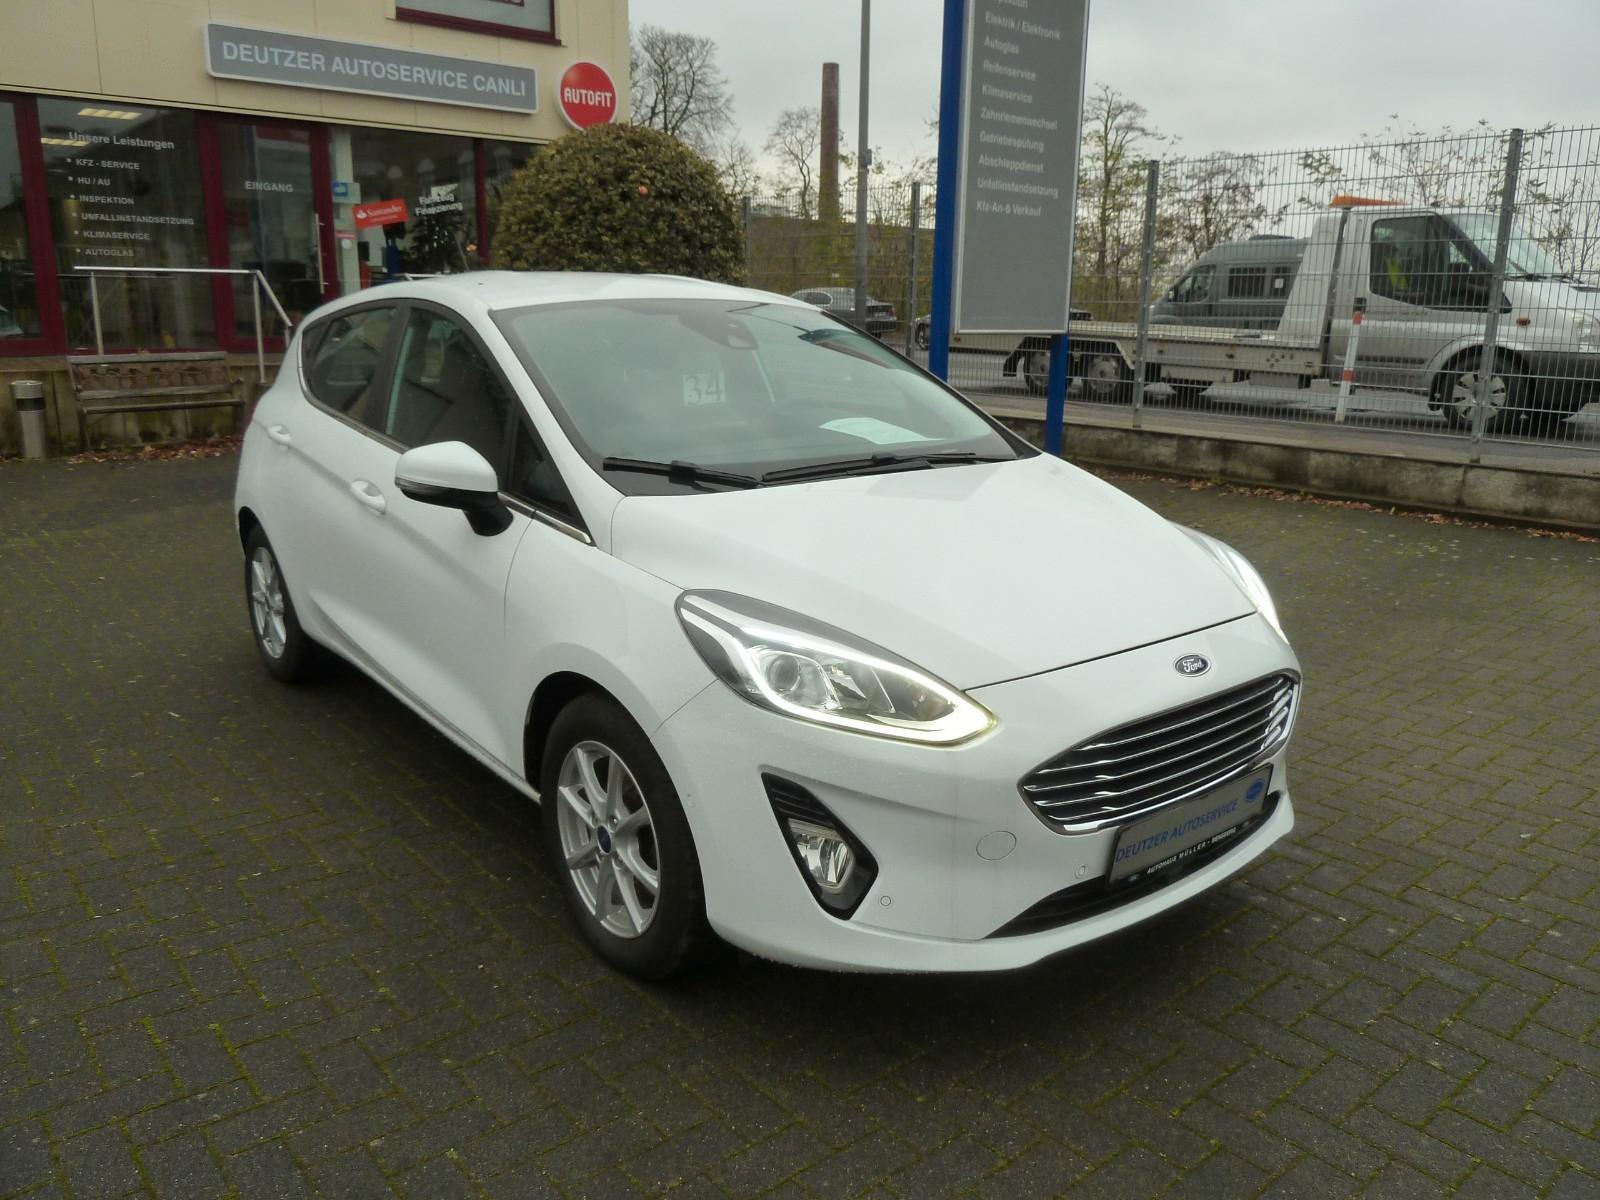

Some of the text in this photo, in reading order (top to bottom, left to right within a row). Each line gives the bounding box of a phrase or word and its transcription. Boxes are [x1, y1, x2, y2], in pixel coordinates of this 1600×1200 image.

[985, 10, 1015, 31] Elektrik
[1021, 20, 1061, 41] Elektronik
[984, 35, 1019, 55] Autoglas
[221, 41, 526, 97] DEUTZER AUTOSERVICE CANLI
[983, 59, 1037, 82] Reifenservice
[564, 87, 612, 107] AUTOFIT
[982, 83, 1033, 104] Klimaservice
[980, 107, 1058, 130] Zahnriemenwechsel
[68, 131, 175, 151] Unsere Leistungen
[76, 158, 96, 167] KFZ
[101, 160, 140, 170] SERVICE
[978, 154, 1044, 174] Abschleppdienst
[78, 176, 91, 185] HU
[98, 178, 111, 186] AU
[245, 181, 294, 193] EINGANG
[977, 177, 1059, 199] Unfallinstandsetzung
[79, 195, 134, 205] INSPEKTION
[1012, 203, 1042, 217] Verkauf
[81, 212, 195, 225] UNFALLINSTANDSETZUNG
[83, 230, 151, 241] KLIMASERVICE
[85, 247, 135, 257] AUTOGLAS
[1115, 831, 1169, 864] DEUTZER
[1169, 799, 1238, 840] AUTOSERVICE
